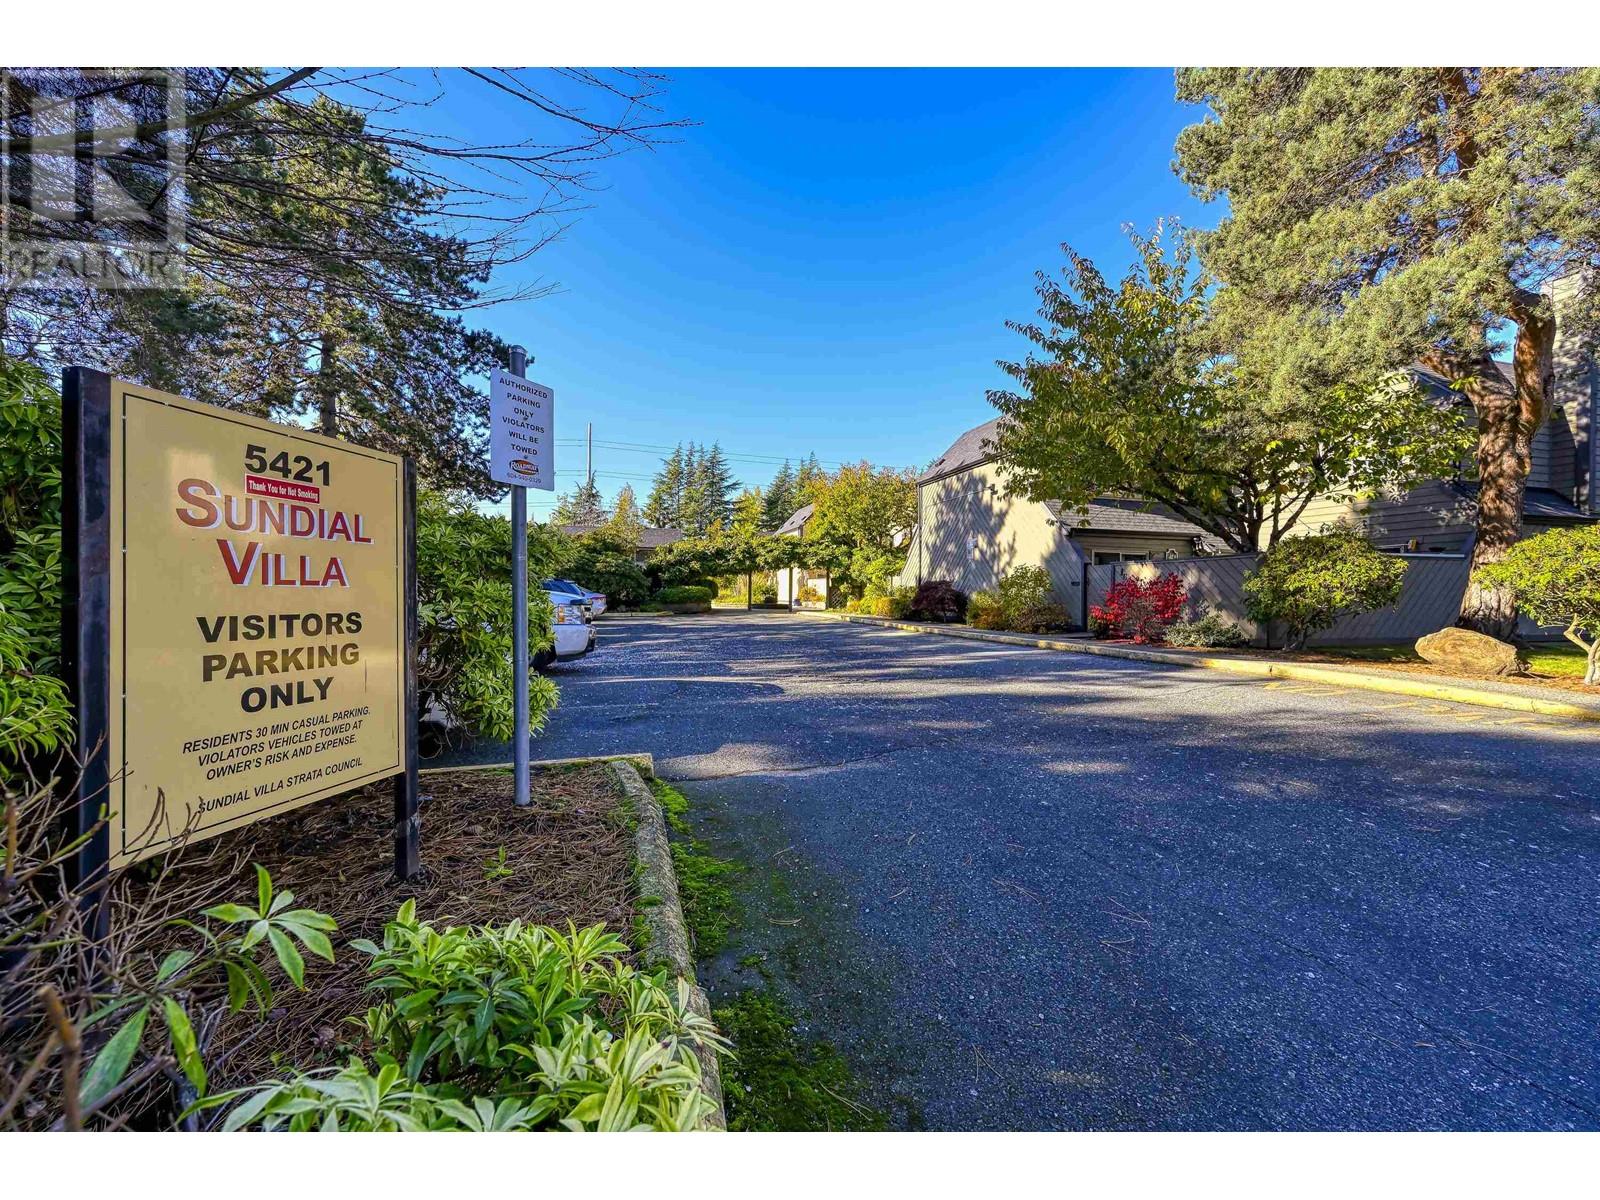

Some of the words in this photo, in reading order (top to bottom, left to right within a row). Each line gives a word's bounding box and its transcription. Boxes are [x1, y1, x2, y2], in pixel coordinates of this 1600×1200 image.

[500, 378, 548, 398] AUTHORIZED
[507, 392, 541, 408] PARKING
[502, 416, 544, 434] VIOLATORS
[514, 408, 534, 418] ONLY
[509, 430, 526, 442] WILL
[529, 435, 539, 444] BE
[511, 443, 538, 456] TOWED
[245, 443, 330, 486] 5421
[249, 480, 266, 492] Thank
[268, 483, 278, 493] You
[288, 487, 296, 496] Not
[298, 488, 318, 502] Smoking
[176, 478, 375, 544] SUNDIAL
[216, 539, 350, 587] VILLA
[196, 612, 362, 643] VISITORS
[202, 643, 359, 682] PARKING
[240, 677, 334, 713] ONLY
[182, 729, 252, 754] RESIDENTS
[256, 726, 268, 738] 30
[270, 722, 290, 734] MIN
[292, 714, 330, 730] CASUAL
[198, 741, 264, 767] VIOLATORS
[268, 731, 316, 749] VEHICLES
[320, 722, 350, 738] TOWED
[352, 720, 364, 730] AT
[206, 757, 262, 780] OWNER'S
[264, 750, 289, 766] RISK
[291, 744, 312, 759] AND
[314, 734, 357, 752] EXPENSE.
[198, 789, 250, 814] SUNDIAL
[254, 780, 284, 798] VILLA
[286, 768, 322, 788] STRATA
[326, 757, 362, 776] COUNCIL
